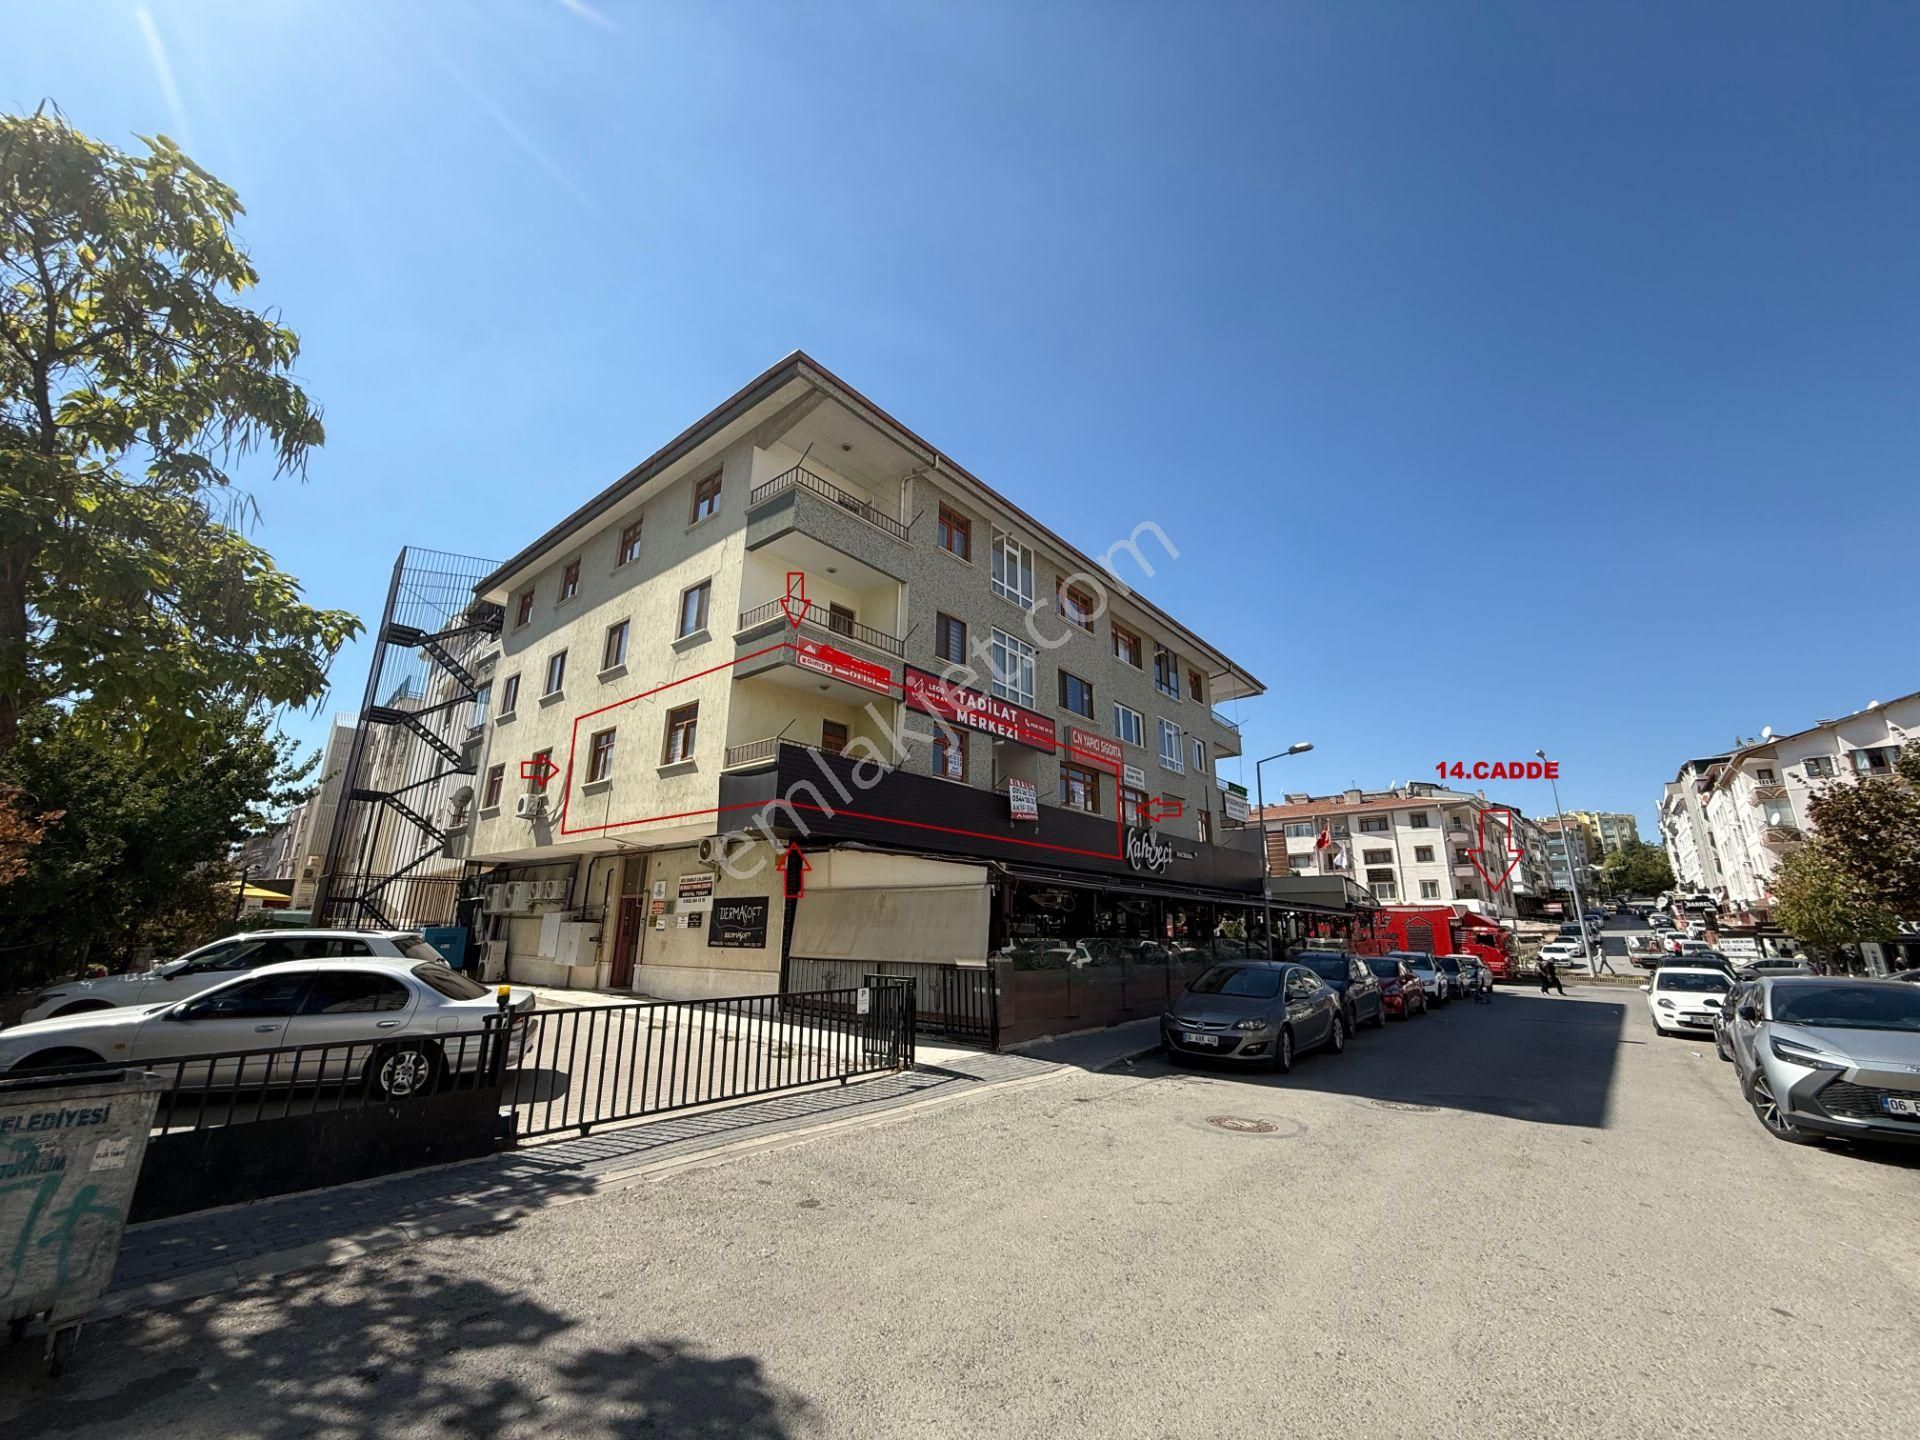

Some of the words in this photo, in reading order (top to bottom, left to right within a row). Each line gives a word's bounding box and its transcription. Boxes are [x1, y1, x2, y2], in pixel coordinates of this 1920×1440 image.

[957, 690, 1018, 723] TADİLAT
[956, 709, 1019, 740] MERKEZİ
[1083, 734, 1100, 751] YAPICI
[719, 904, 763, 927] DERMASOFT
[0, 1103, 111, 1132] ELEDİYESİ
[1890, 1099, 1907, 1111] 06
